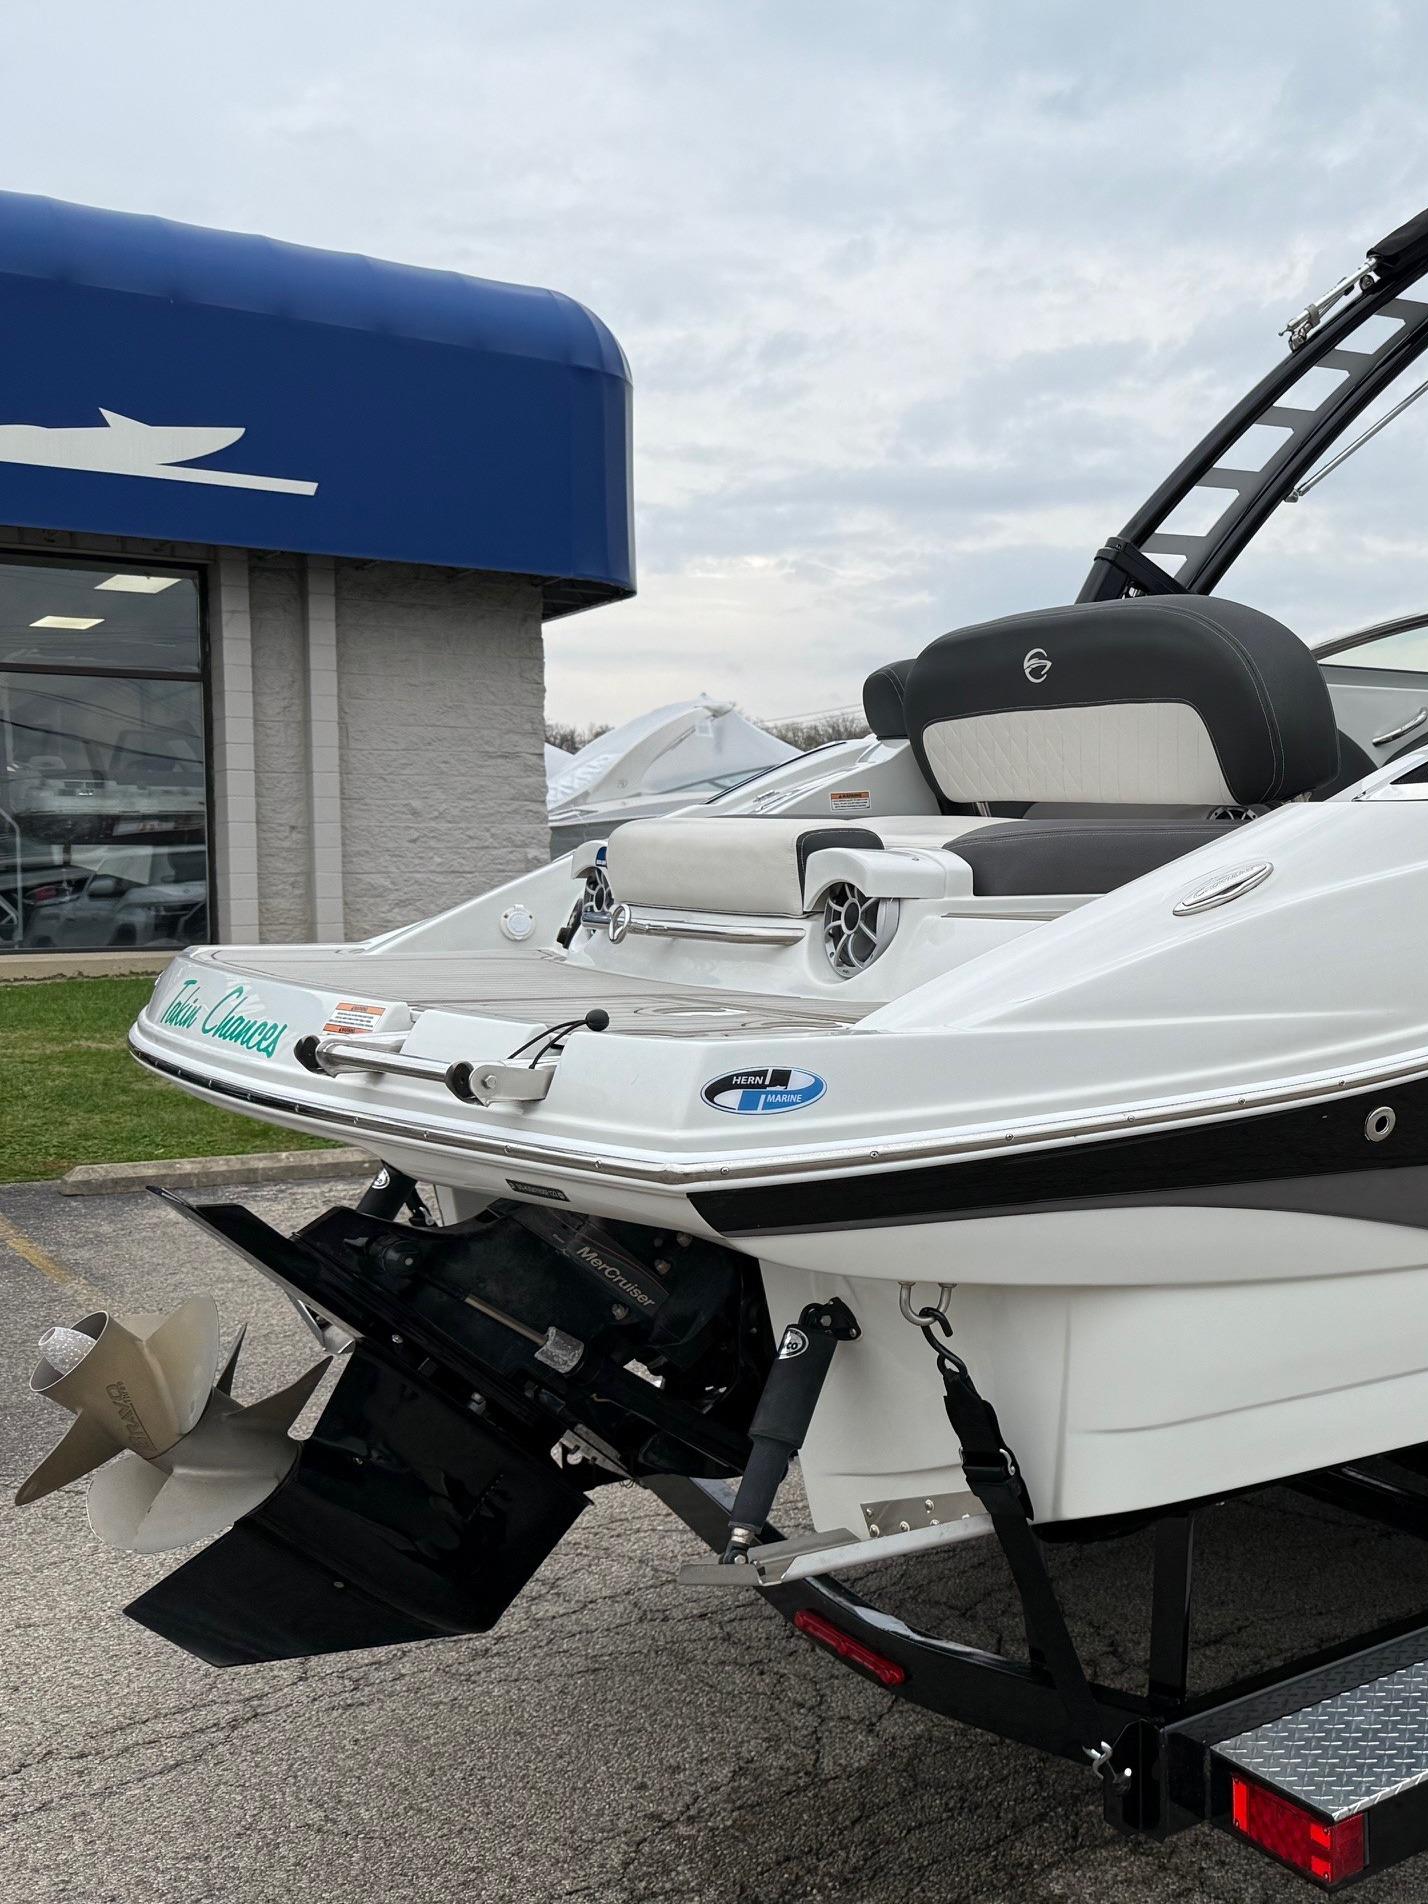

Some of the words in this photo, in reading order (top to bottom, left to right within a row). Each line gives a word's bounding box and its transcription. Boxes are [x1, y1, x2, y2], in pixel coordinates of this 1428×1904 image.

[201, 985, 288, 1059] Chances
[732, 1076, 764, 1085] HERN
[766, 1094, 803, 1103] MARINE
[576, 1246, 656, 1306] MerCruiser
